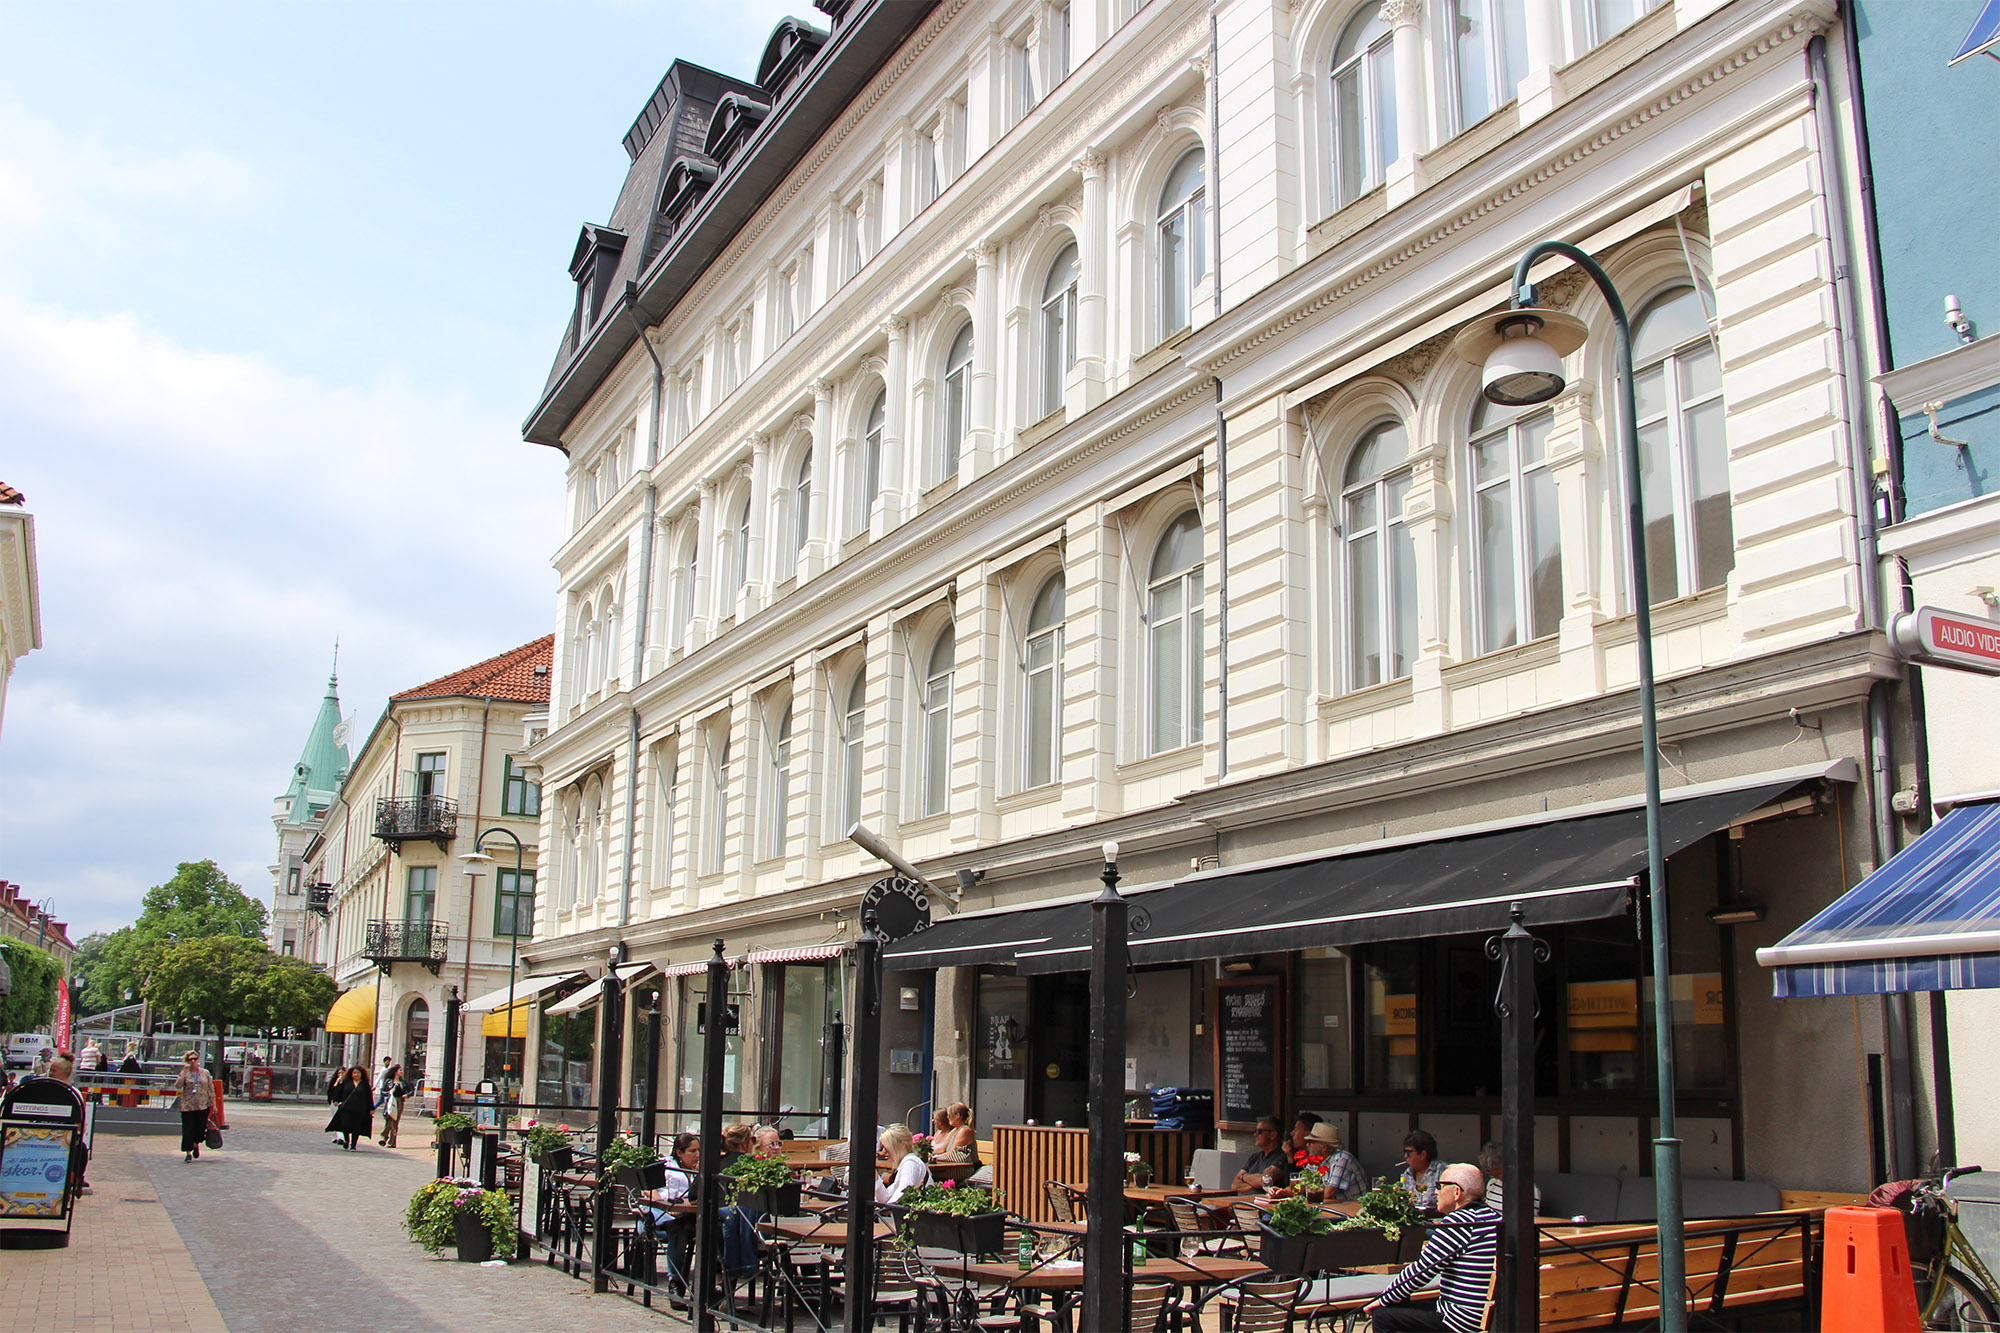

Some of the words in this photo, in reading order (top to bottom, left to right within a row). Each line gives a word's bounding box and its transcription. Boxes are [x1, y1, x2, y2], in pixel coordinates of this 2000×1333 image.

[1941, 625, 1975, 648] AUDIO
[865, 877, 929, 911] TYCHO
[15, 1104, 48, 1112] WITTINGS
[3, 1162, 48, 1177] skor!
